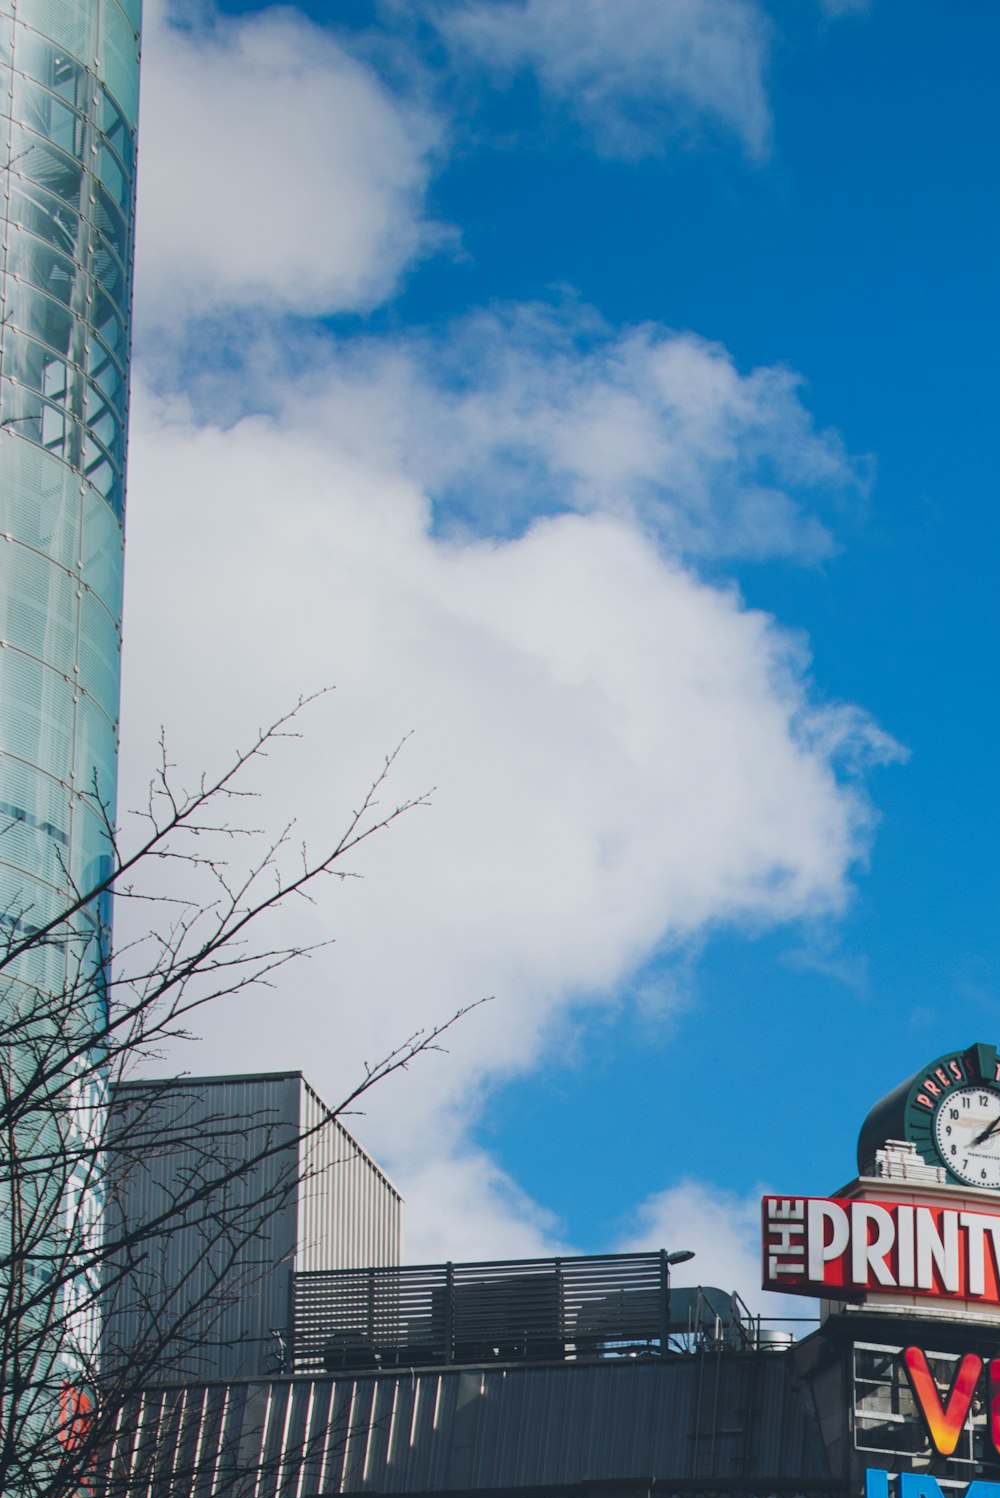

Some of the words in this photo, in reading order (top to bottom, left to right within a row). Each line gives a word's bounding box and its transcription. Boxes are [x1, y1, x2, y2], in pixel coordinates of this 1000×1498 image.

[962, 1097, 970, 1108] 11
[979, 1095, 988, 1107] 12
[950, 1109, 959, 1120] 10
[946, 1126, 952, 1136] 9
[951, 1145, 957, 1155] 8
[967, 1152, 1000, 1160] MANCHESTER
[963, 1160, 968, 1170] 7
[981, 1168, 987, 1178] 6
[768, 1200, 805, 1279] THE
